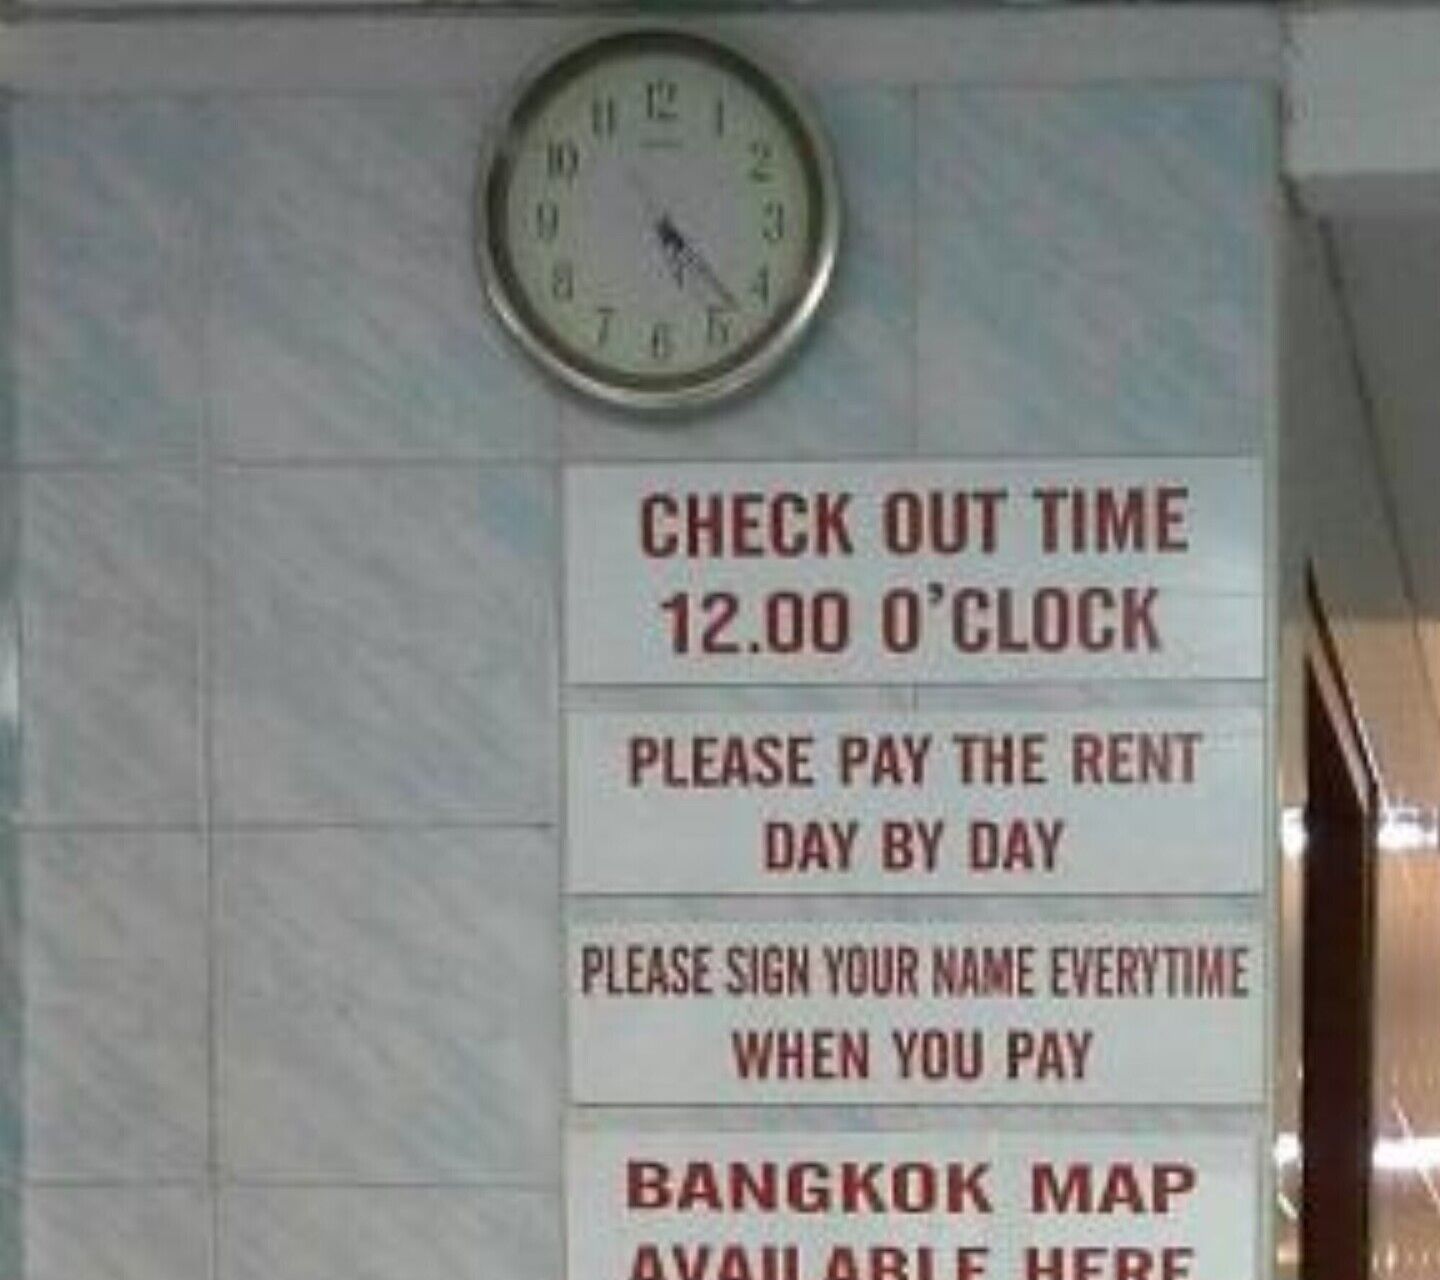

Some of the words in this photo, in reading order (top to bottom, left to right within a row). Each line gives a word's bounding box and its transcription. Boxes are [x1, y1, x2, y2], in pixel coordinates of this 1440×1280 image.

[592, 95, 615, 137] 11
[645, 79, 679, 121] 12
[714, 97, 726, 137] 1
[546, 140, 580, 183] 10
[747, 143, 773, 182] 2
[536, 201, 560, 240] 9
[762, 202, 784, 242] 3
[551, 261, 575, 302] 8
[751, 264, 771, 305] 4
[595, 307, 617, 346] 7
[650, 320, 673, 360] 6
[640, 491, 854, 559] CHECK
[882, 488, 1009, 556] OUT
[1031, 486, 1189, 554] TIME
[660, 589, 850, 655] 12.00
[882, 582, 1160, 654] O'CLOCK
[629, 735, 815, 788] PLEASE
[839, 734, 932, 787] PAY
[952, 734, 1047, 785] THE
[1073, 733, 1201, 784] RENT
[765, 821, 859, 872] DAY
[882, 820, 944, 872] BY
[969, 819, 1064, 871] DAY
[582, 945, 713, 996] PLEASE
[726, 945, 809, 997] SIGN
[823, 945, 919, 997] YOUR
[933, 946, 1035, 997] NAME
[1051, 946, 1249, 997] EVERYTIME
[732, 1029, 869, 1080] WHEN
[892, 1029, 983, 1081] YOU
[1007, 1030, 1092, 1080] PAY
[627, 1160, 992, 1213] BANGKOK
[1032, 1164, 1196, 1214] MAP
